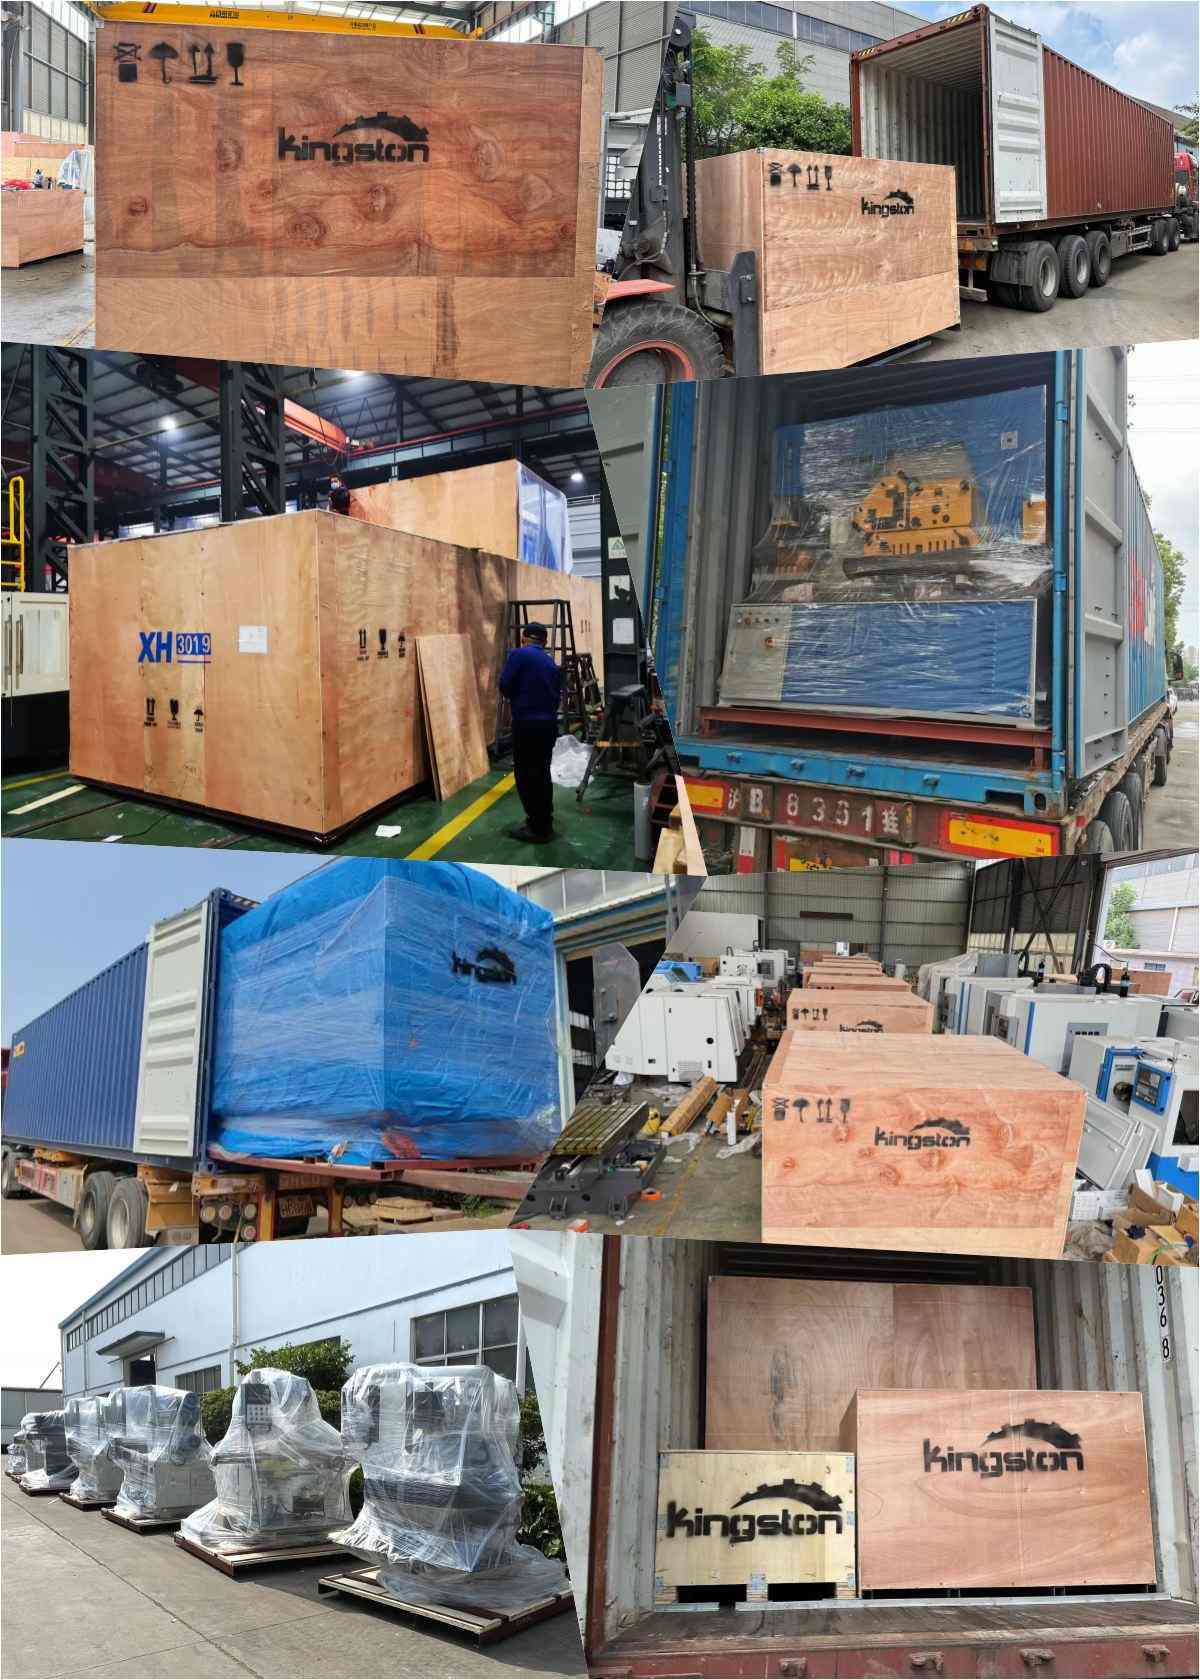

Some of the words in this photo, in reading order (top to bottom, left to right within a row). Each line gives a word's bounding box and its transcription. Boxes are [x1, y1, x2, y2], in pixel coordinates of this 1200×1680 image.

[138, 631, 173, 663] XH
[176, 633, 211, 655] 3019
[665, 1500, 843, 1544] kingston
